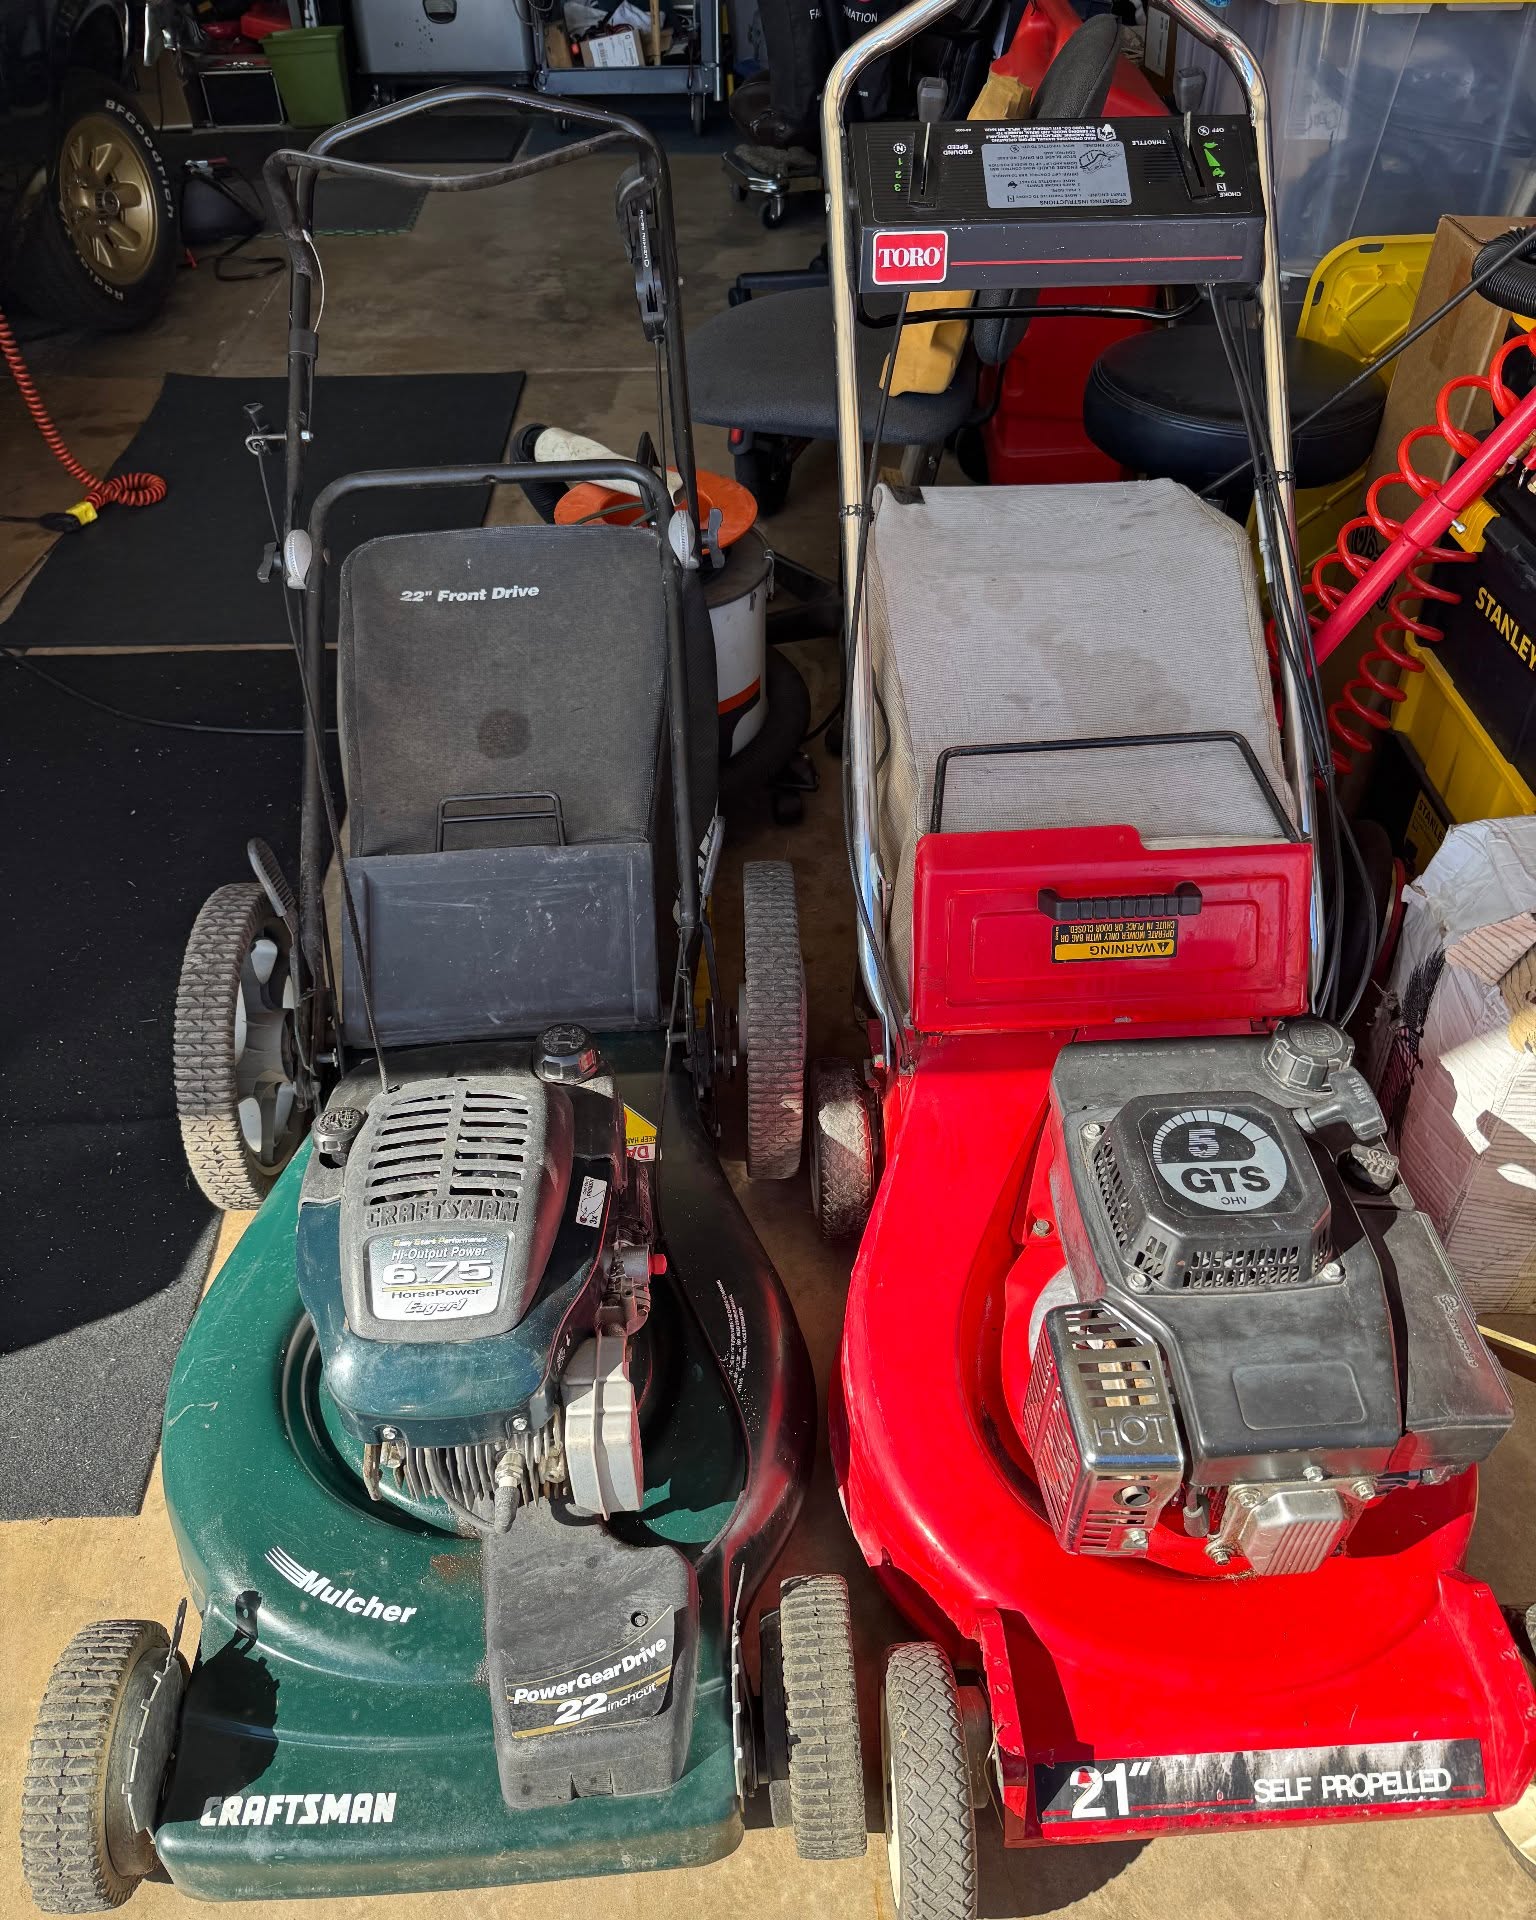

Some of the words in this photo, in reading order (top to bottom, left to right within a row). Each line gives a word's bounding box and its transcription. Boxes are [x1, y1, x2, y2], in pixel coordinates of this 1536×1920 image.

[105, 98, 174, 219] BFGoodrich
[894, 184, 902, 192] 3
[878, 246, 941, 268] TORO
[399, 590, 433, 602] 22"
[437, 588, 488, 602] Front
[491, 585, 540, 600] Drive
[1475, 586, 1536, 672] STANLEY
[1417, 799, 1446, 844] STANLE
[1068, 925, 1094, 934] CLOSED.
[1095, 924, 1113, 932] DOOR
[1114, 923, 1124, 932] OR
[1125, 922, 1145, 931] PLACE
[1145, 922, 1154, 930] IN
[1155, 920, 1175, 930] CHUTE
[1060, 934, 1070, 943] OR
[1071, 934, 1084, 943] BAG
[1085, 933, 1102, 942] WITH
[1104, 932, 1120, 941] ONLY
[1121, 931, 1146, 940] MOWER
[1147, 929, 1175, 939] OPERATE
[1089, 943, 1156, 956] WARNING
[1347, 1077, 1371, 1105] START
[1188, 1128, 1220, 1158] 5
[625, 1145, 650, 1159] DA
[1180, 1165, 1271, 1194] GTS
[365, 1198, 520, 1230] CRAFTSMAN
[392, 1239, 412, 1247] Easy
[436, 1236, 488, 1244] Performance
[391, 1247, 448, 1261] Hi-Output
[450, 1246, 488, 1258] Power
[382, 1259, 493, 1285] 6.75
[391, 1288, 482, 1299] HorsePower
[1092, 1413, 1168, 1447] HOT
[301, 1569, 418, 1623] Mulcher
[554, 1692, 608, 1726] 22
[1068, 1761, 1152, 1819] 21"
[1253, 1776, 1312, 1804] SELF
[1320, 1767, 1453, 1799] PROPELLED
[199, 1792, 397, 1827] CRAFTSMAN
